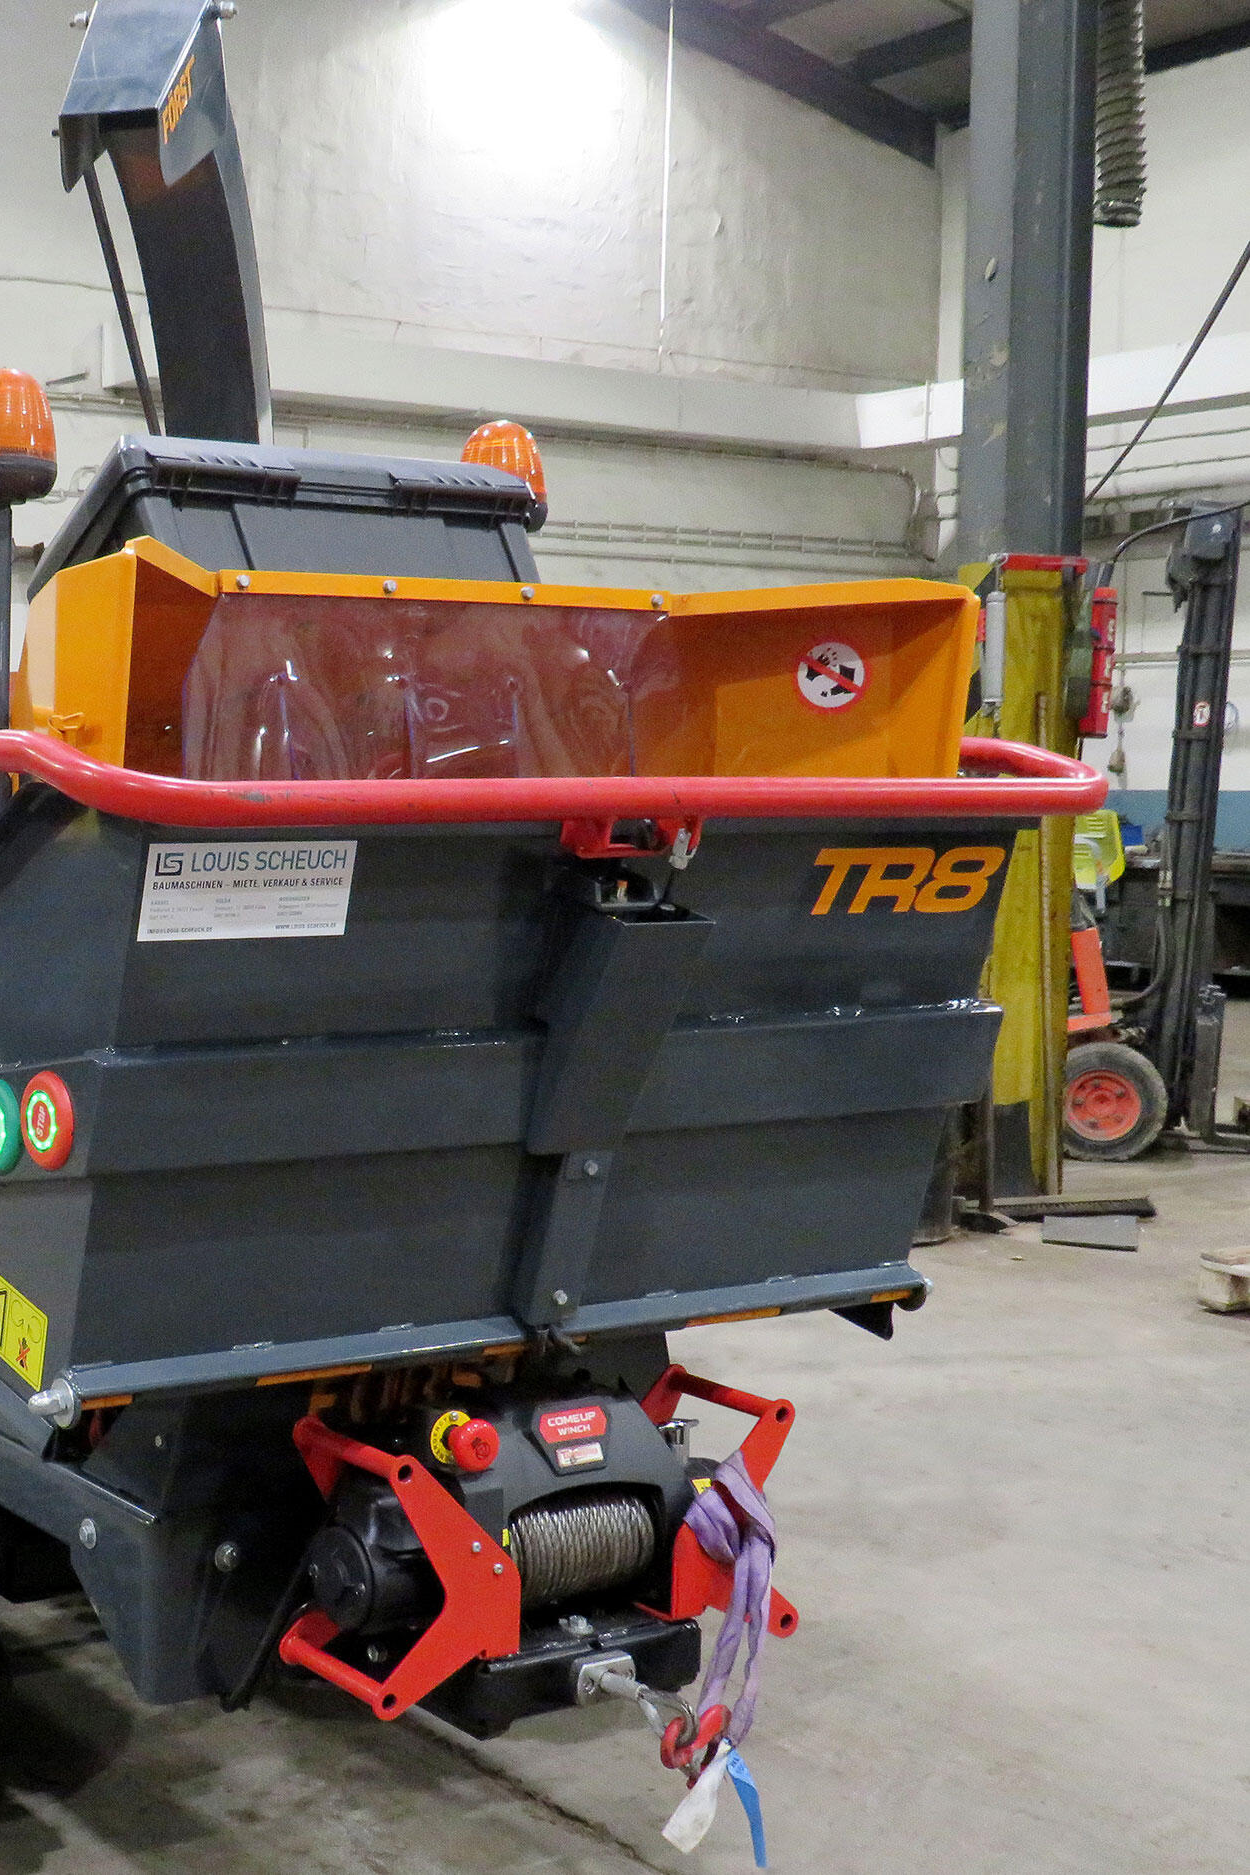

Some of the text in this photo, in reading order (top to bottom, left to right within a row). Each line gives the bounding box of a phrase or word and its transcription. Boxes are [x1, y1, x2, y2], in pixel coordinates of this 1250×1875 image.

[162, 54, 196, 144] FÖRST
[191, 851, 250, 873] LOUIS
[254, 849, 347, 871] SCHEUCH
[152, 880, 223, 890] BAUMASCHINEN
[263, 878, 301, 888] VERKAUF
[309, 876, 344, 886] SERVICE
[811, 846, 1006, 915] TR8
[35, 1105, 46, 1137] STOP
[547, 1411, 596, 1427] COMEUP
[557, 1424, 591, 1436] WINCH
